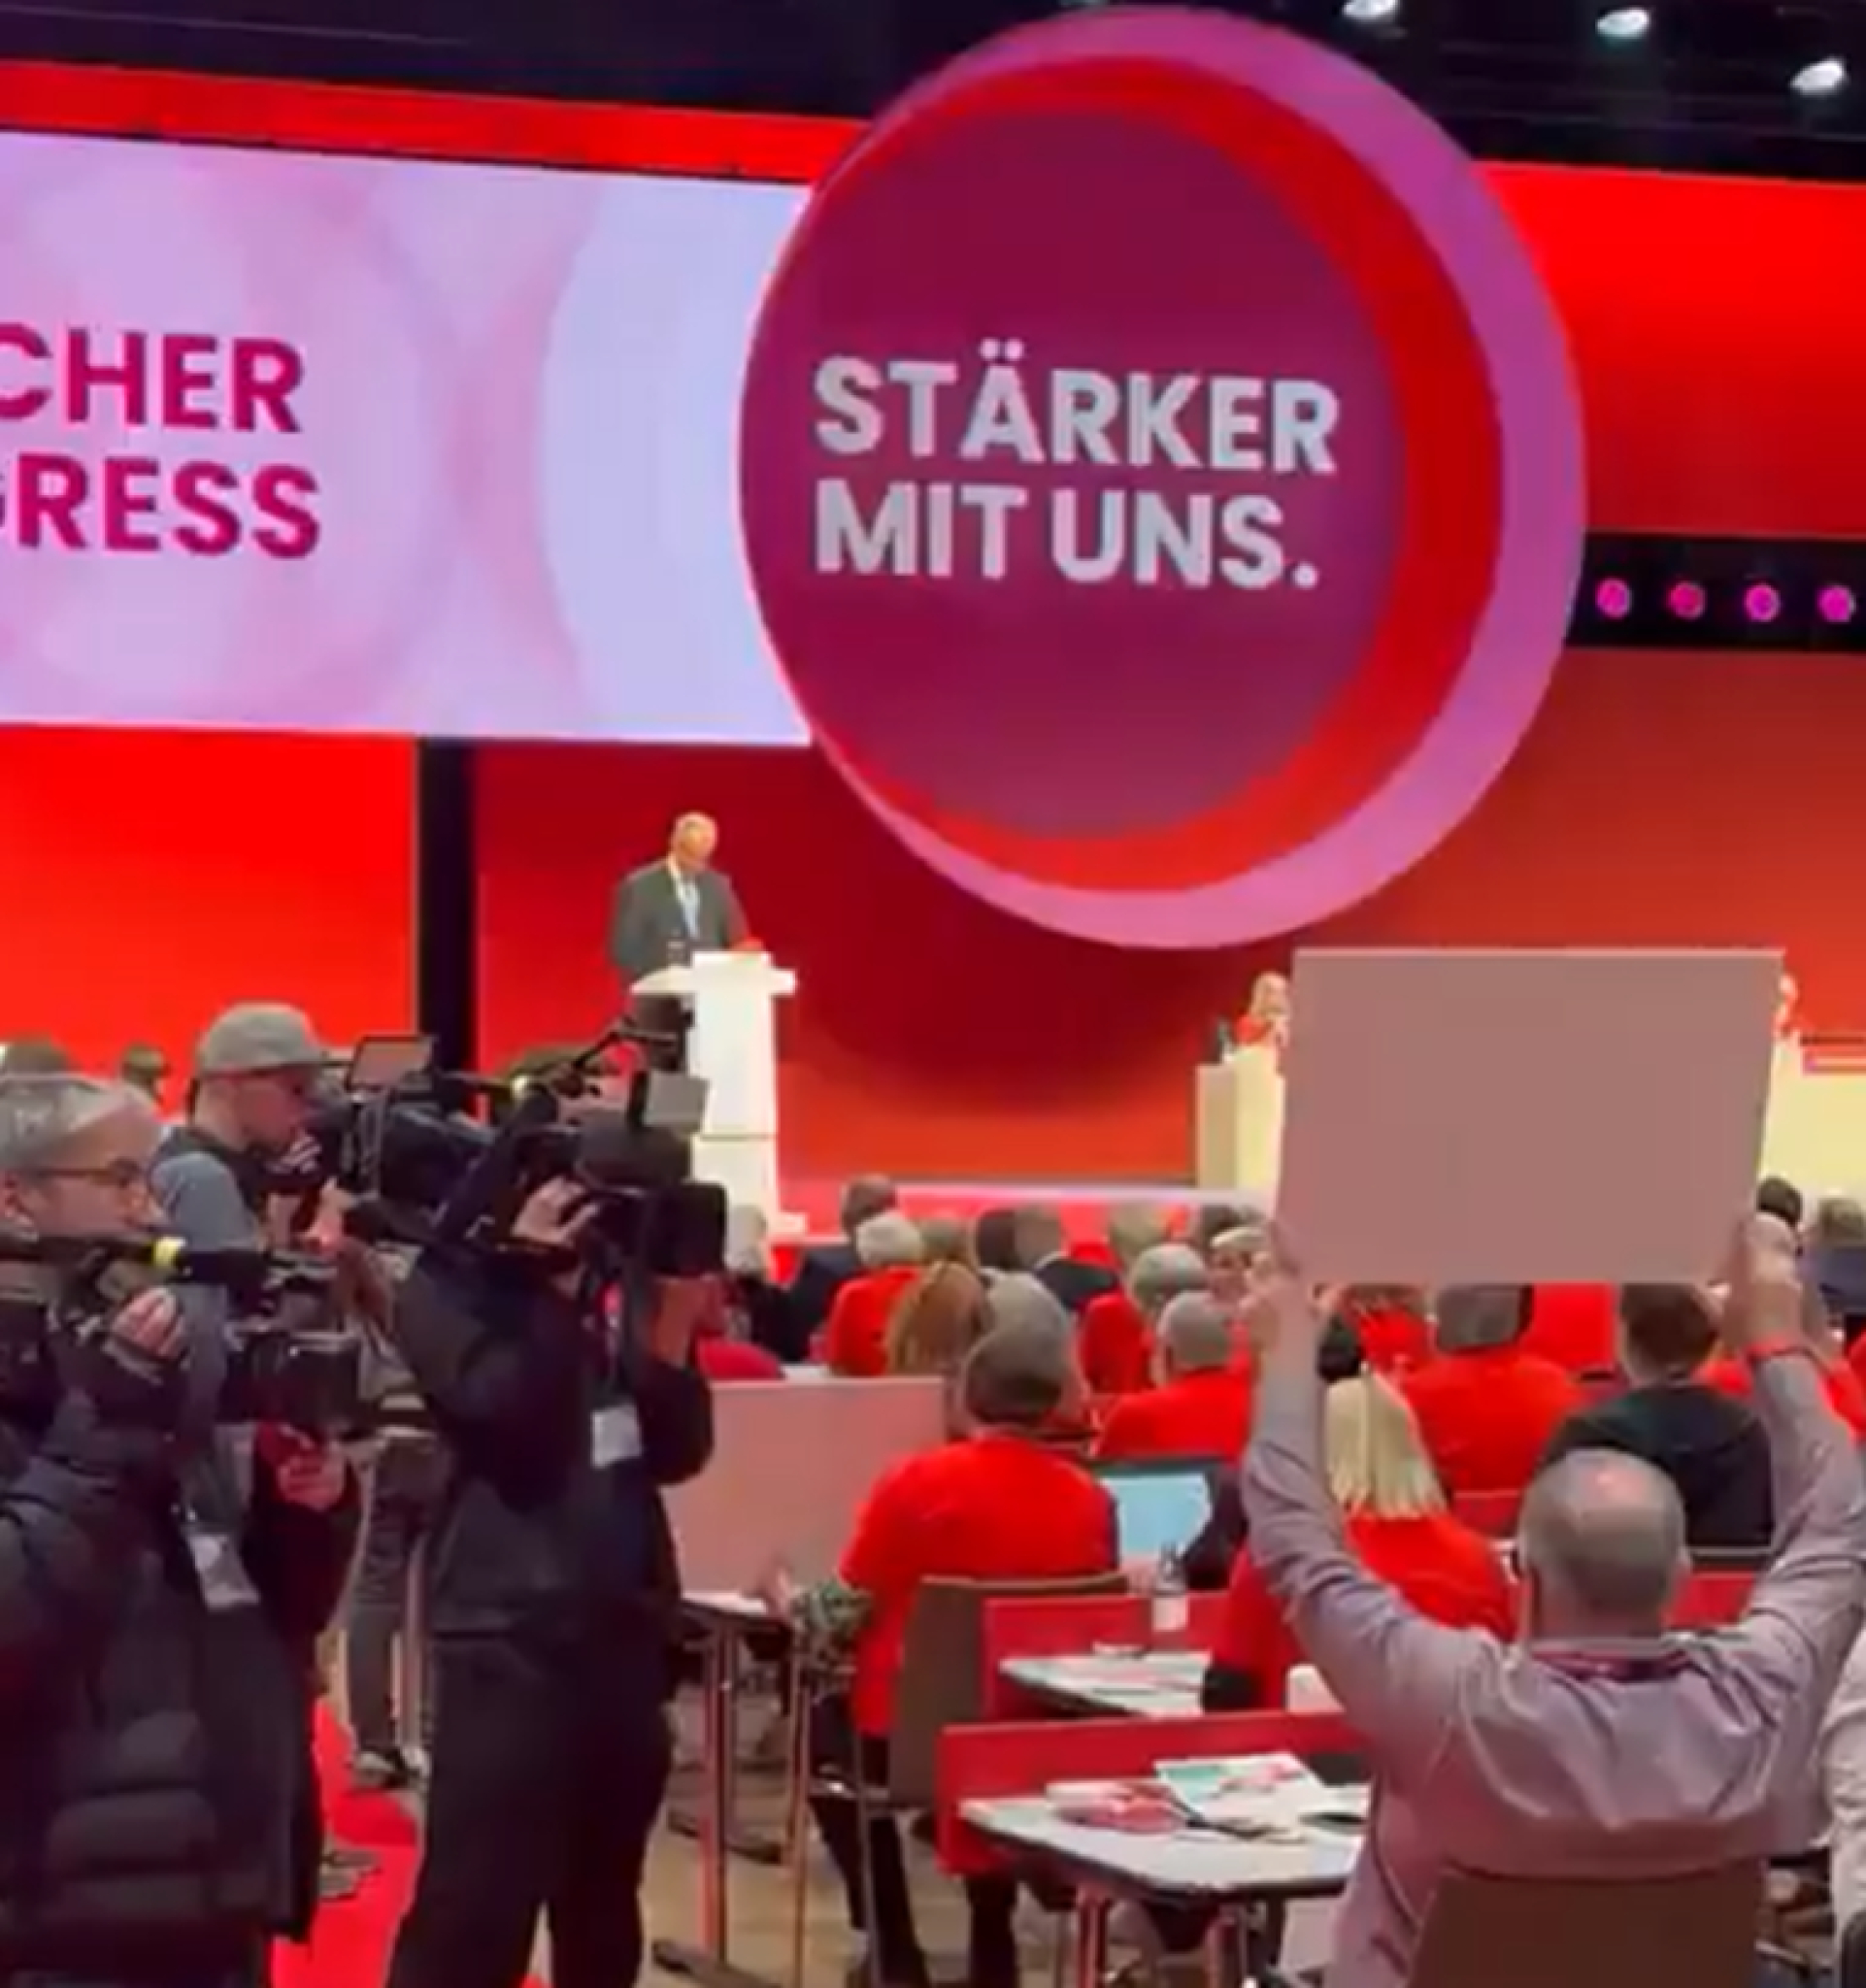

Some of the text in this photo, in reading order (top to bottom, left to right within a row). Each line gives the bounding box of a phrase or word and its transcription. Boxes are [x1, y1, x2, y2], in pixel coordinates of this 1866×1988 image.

[814, 338, 1340, 475] STÄRKER
[0, 451, 321, 560] RESS
[816, 478, 1318, 589] MIT UNS.
